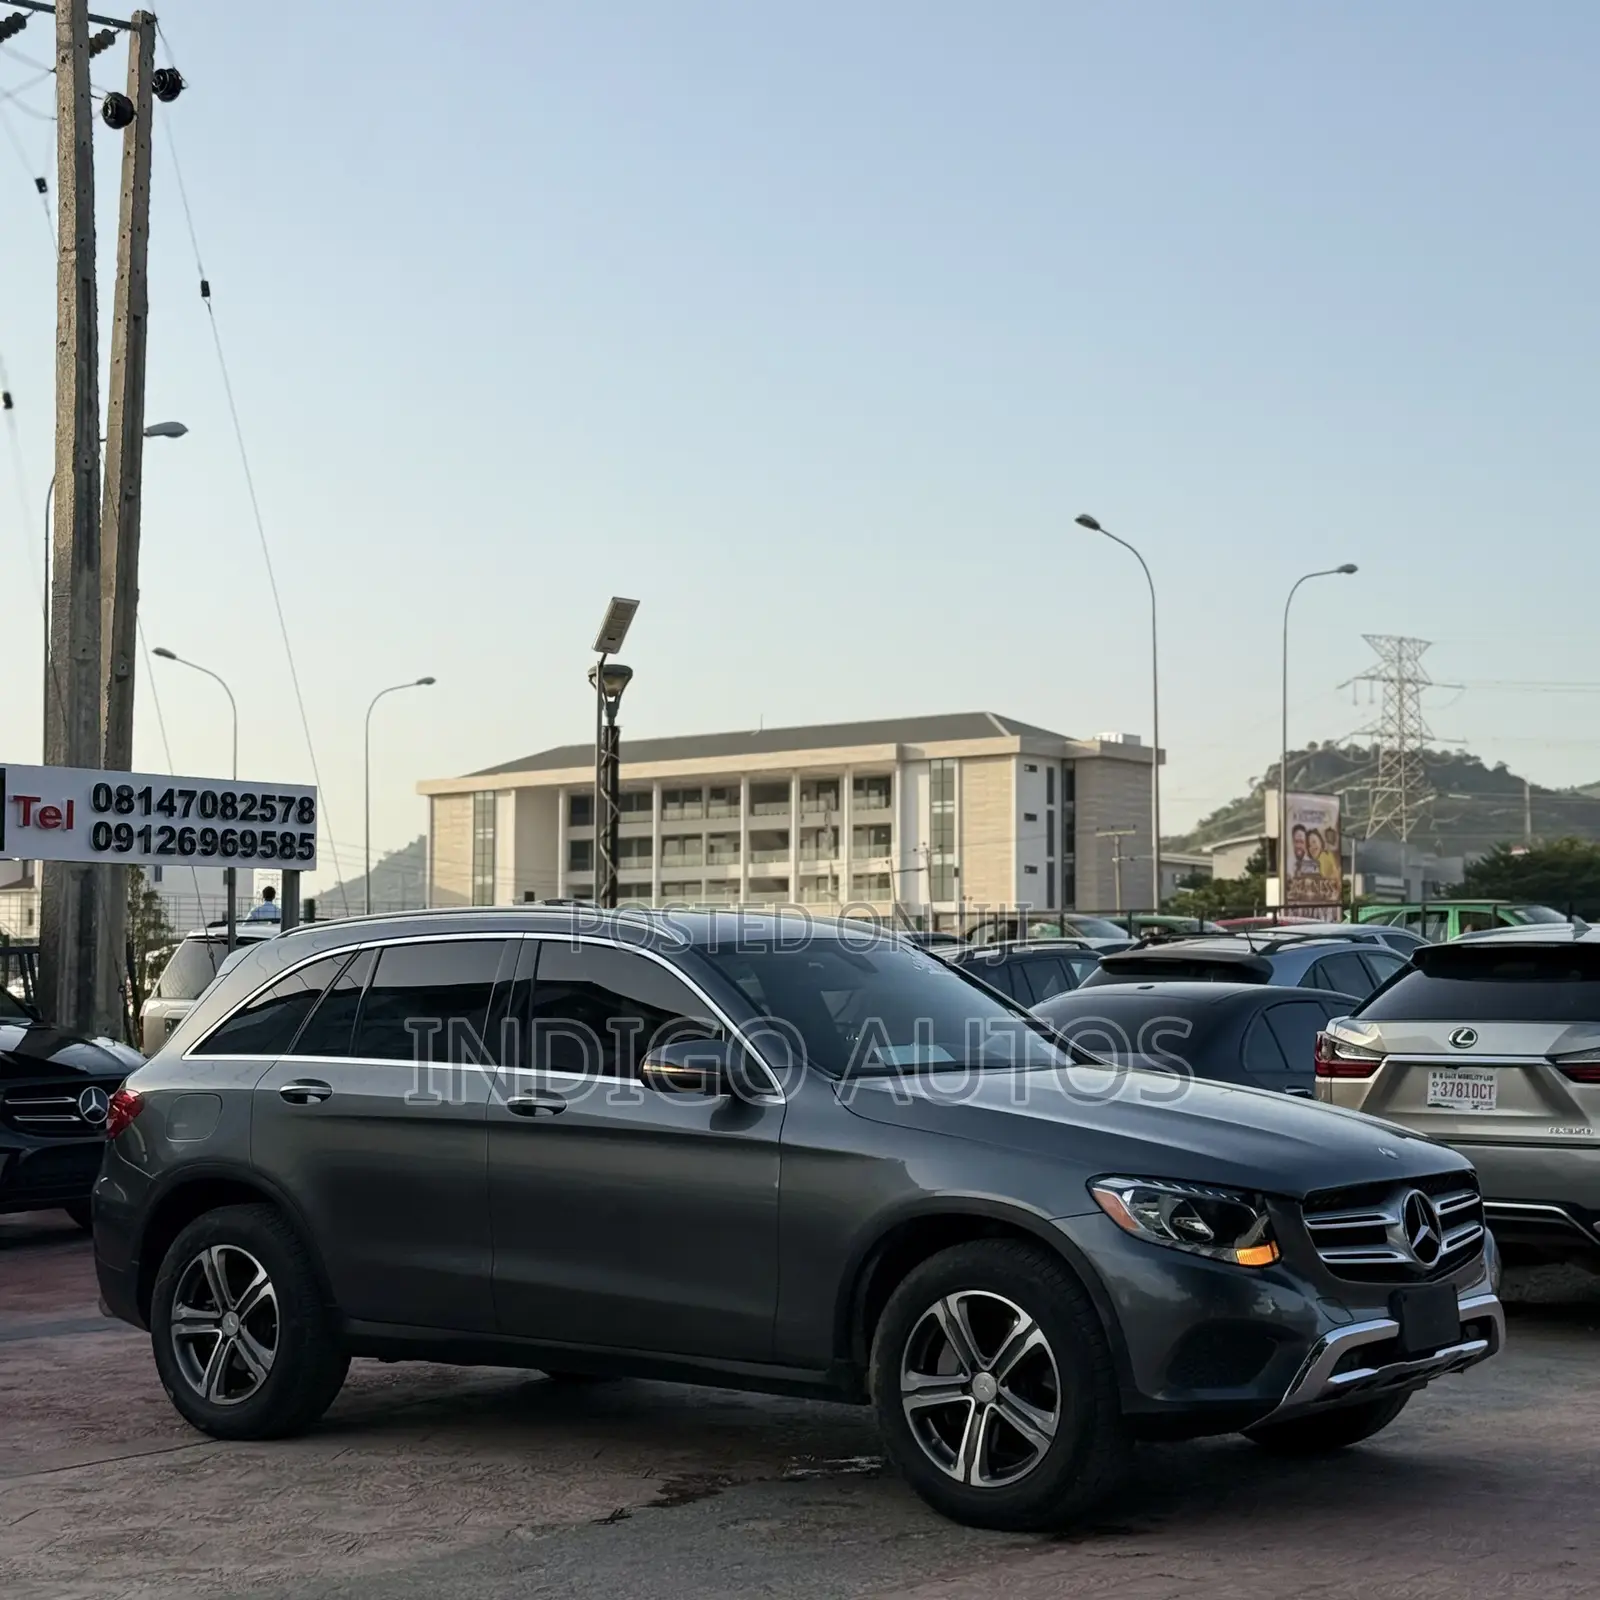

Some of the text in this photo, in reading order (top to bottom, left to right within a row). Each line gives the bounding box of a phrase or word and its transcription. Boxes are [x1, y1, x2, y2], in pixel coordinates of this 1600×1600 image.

[10, 783, 315, 830] Tel 08147082578
[90, 821, 315, 860] 09126969585
